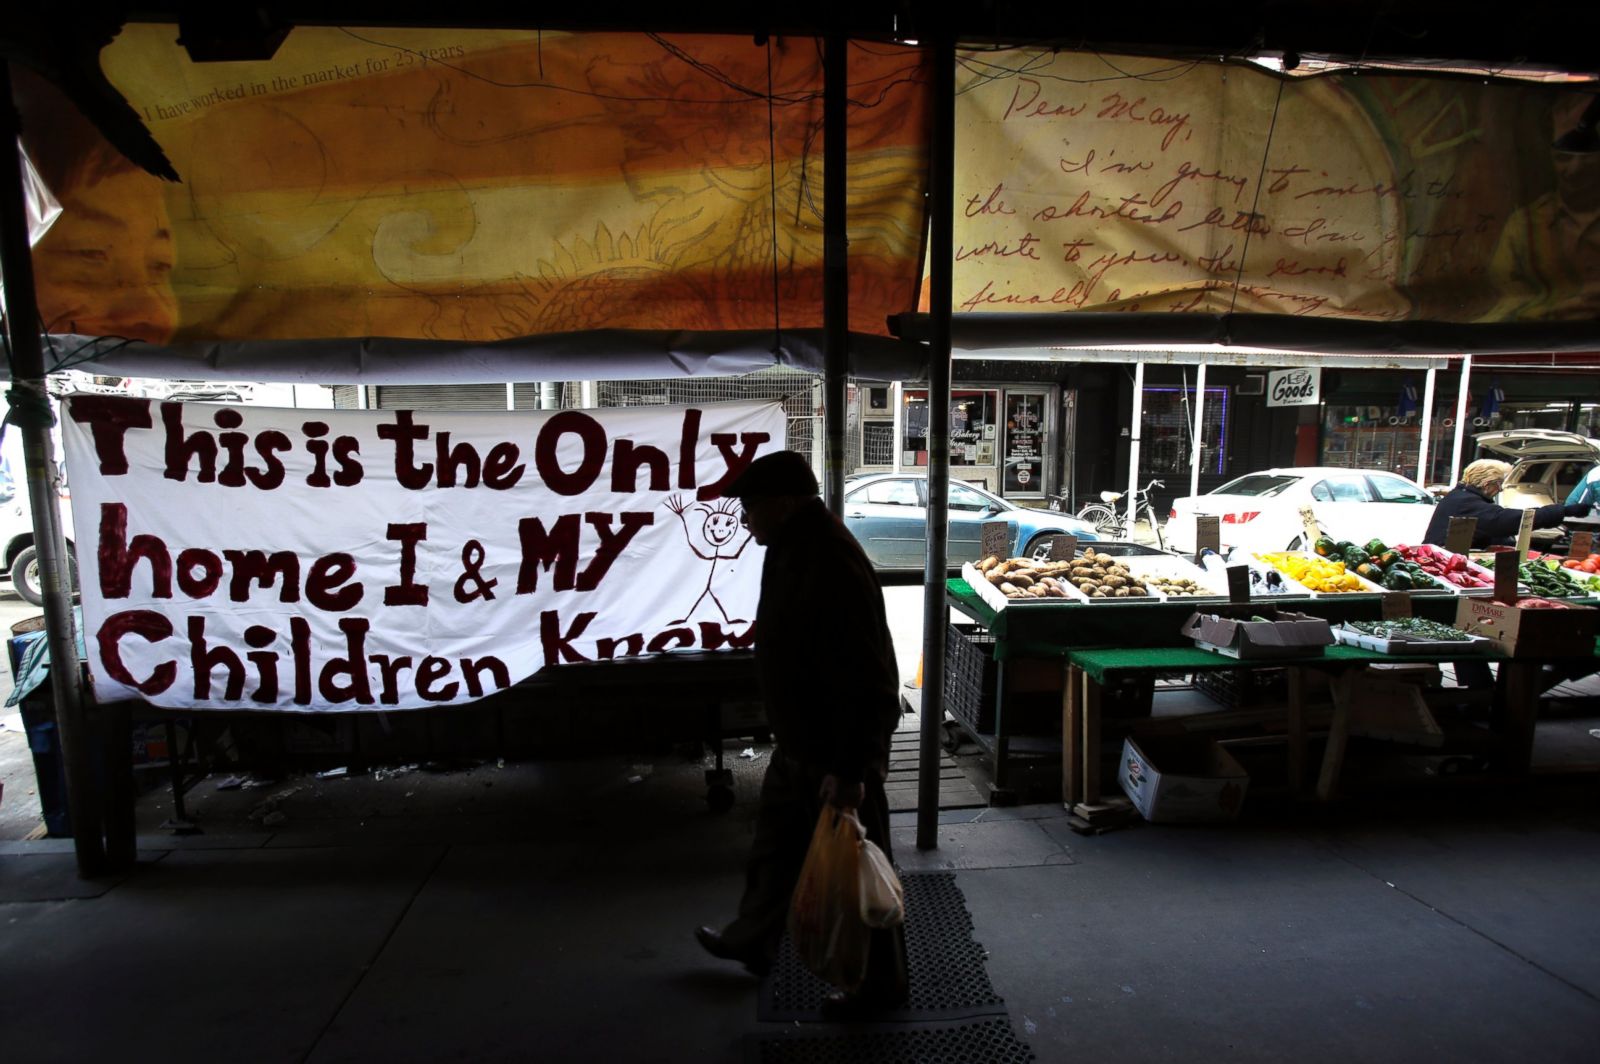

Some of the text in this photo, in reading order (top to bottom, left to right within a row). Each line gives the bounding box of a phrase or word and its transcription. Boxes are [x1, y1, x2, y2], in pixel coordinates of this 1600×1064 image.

[143, 44, 465, 121] I have worked in the market for 25 years
[1003, 76, 1087, 121] Dear
[964, 182, 1016, 218] the
[1033, 190, 1183, 223] shortest
[1060, 149, 1154, 176] I'm
[1149, 161, 1248, 208] going
[955, 232, 1040, 262] write
[1063, 238, 1094, 262] to
[68, 395, 771, 502] This is the Only
[949, 437, 965, 448] tore
[951, 428, 980, 442] Bakery
[97, 502, 366, 612] home
[383, 522, 430, 608] I
[452, 539, 504, 604] &
[94, 608, 512, 706] Children
